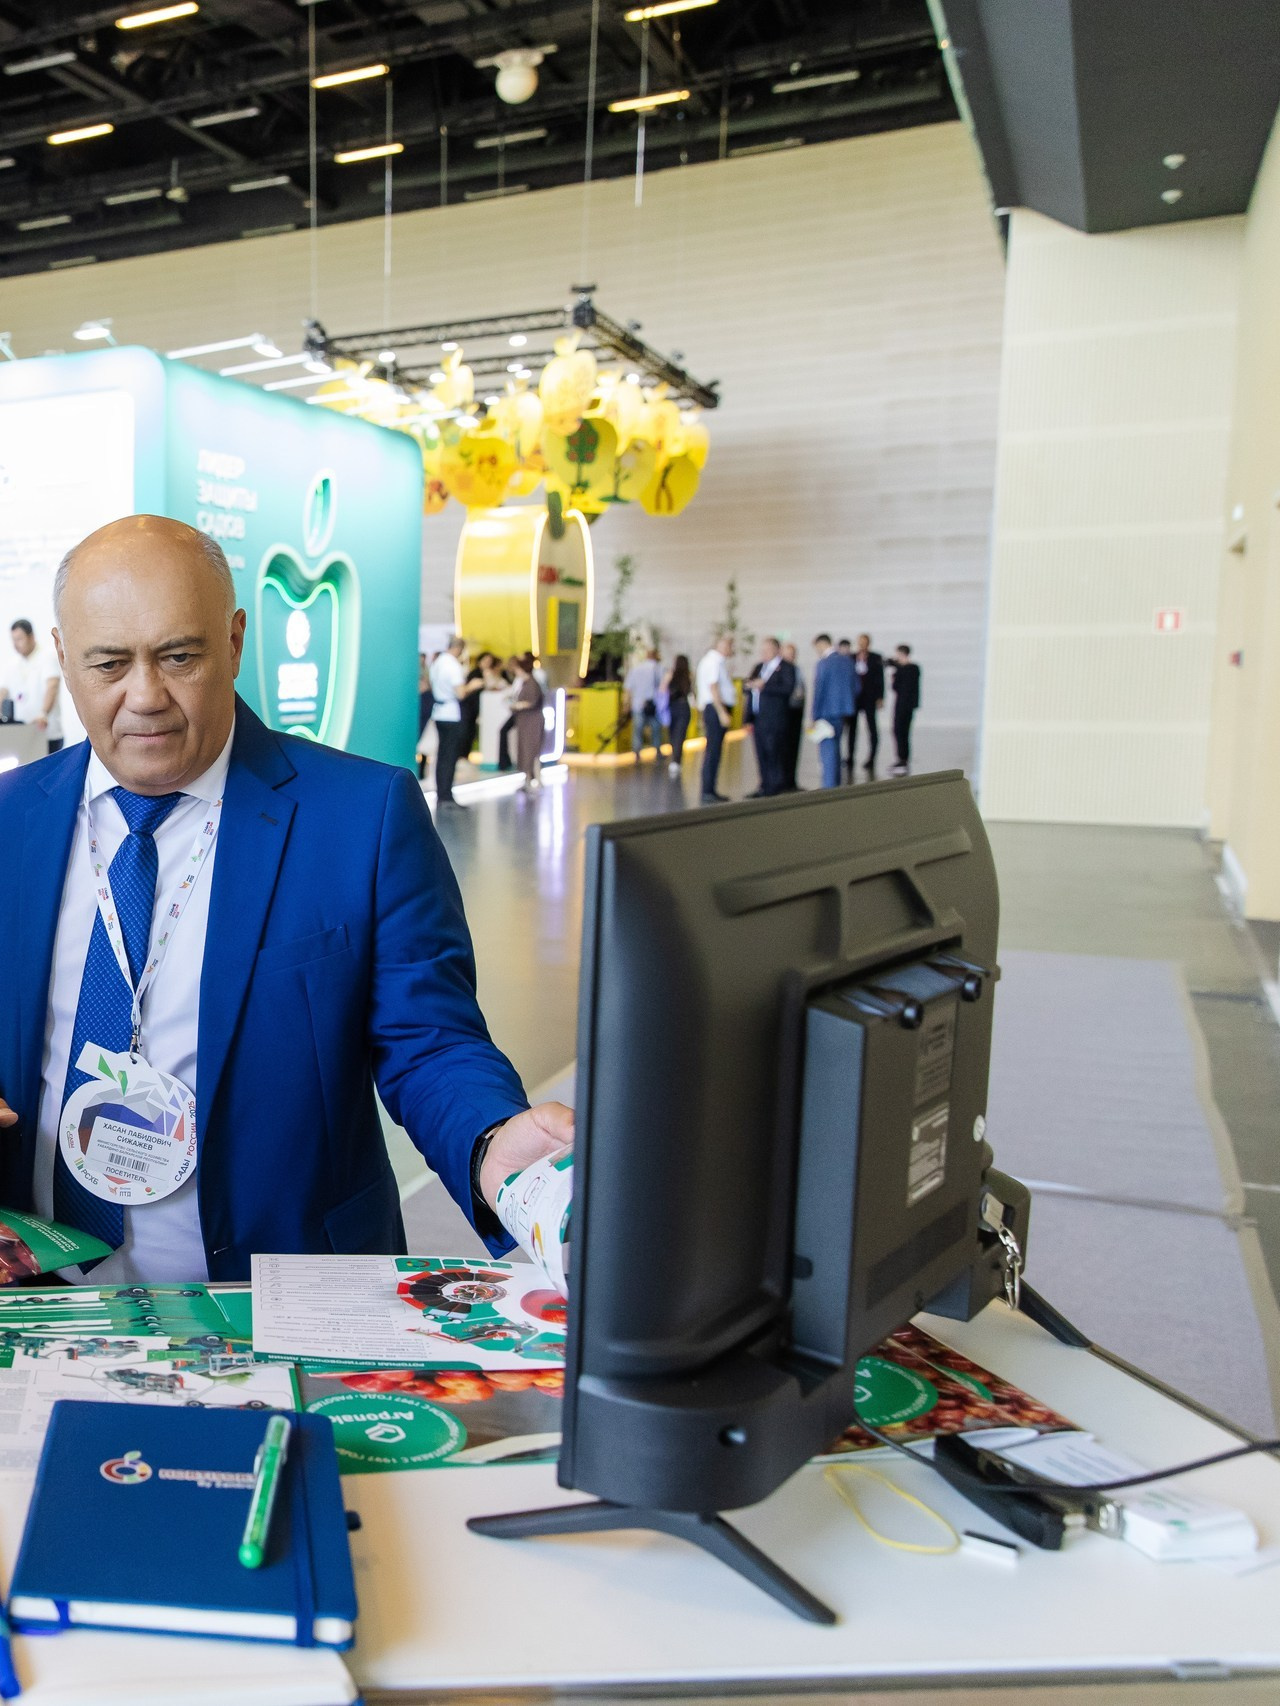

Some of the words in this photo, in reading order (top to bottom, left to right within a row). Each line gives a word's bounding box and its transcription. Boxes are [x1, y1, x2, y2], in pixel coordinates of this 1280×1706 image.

[187, 1100, 197, 1119] 2025
[103, 1122, 127, 1135] ХАСАН
[128, 1129, 172, 1147] ЛАБИДОВИЧ
[117, 1135, 153, 1151] СИЖАЖЕВ
[187, 1122, 197, 1156] РОССИИ
[81, 1168, 98, 1185] РСХБ
[105, 1166, 147, 1183] ПОСЕТИТЕЛЬ
[175, 1159, 191, 1182] САДЫ
